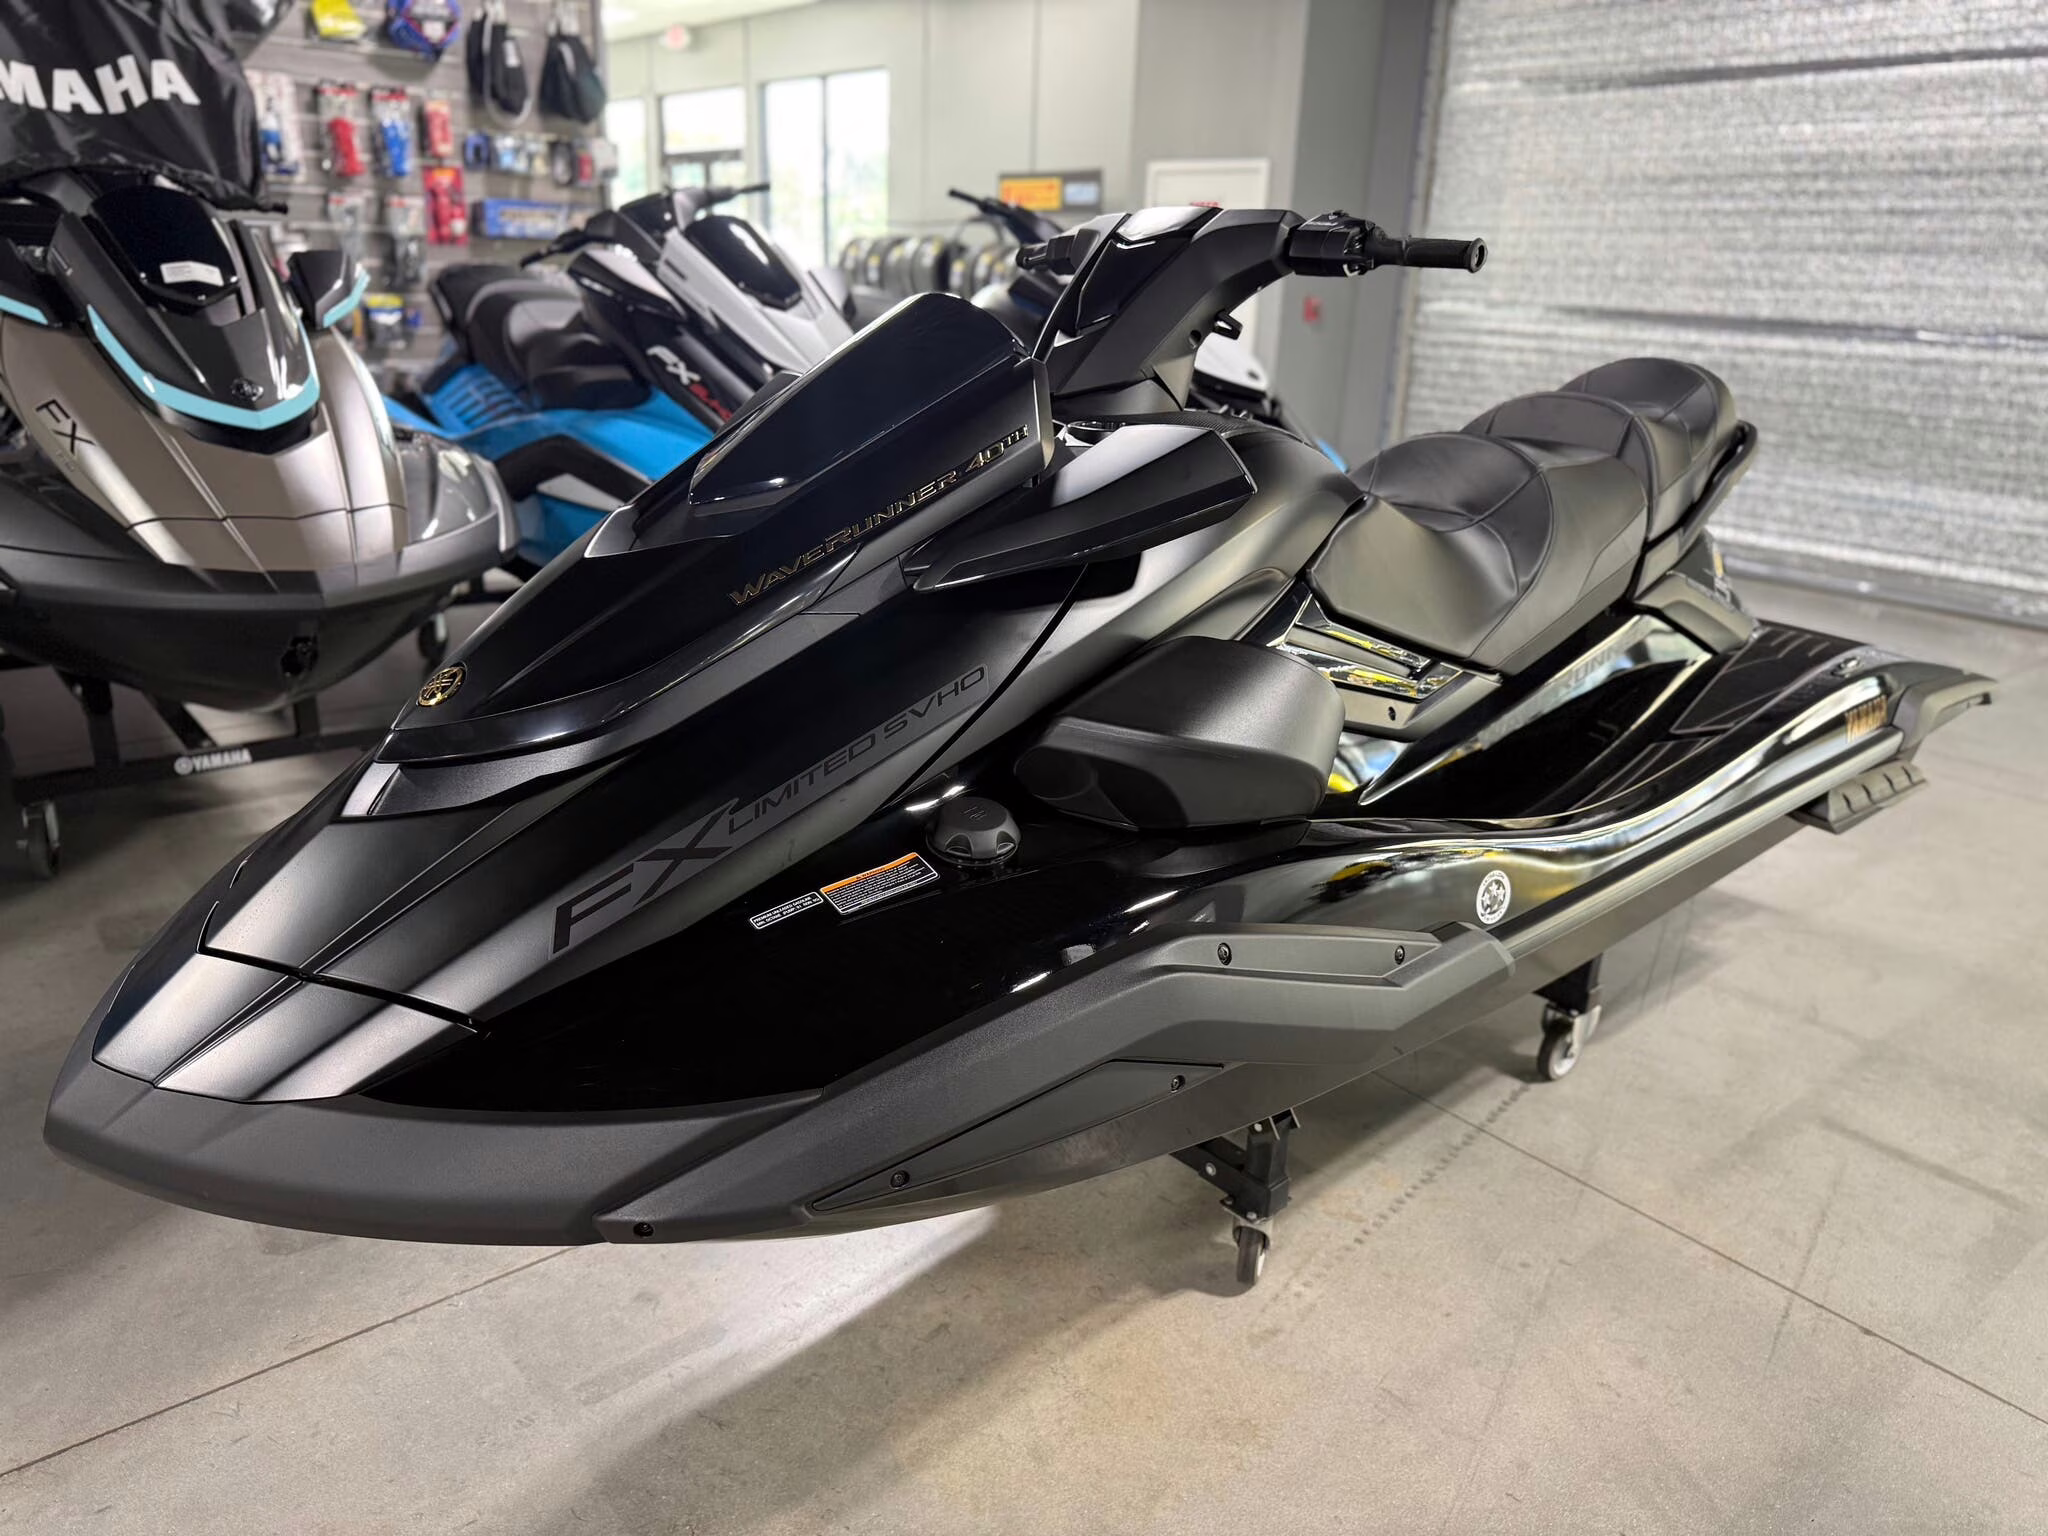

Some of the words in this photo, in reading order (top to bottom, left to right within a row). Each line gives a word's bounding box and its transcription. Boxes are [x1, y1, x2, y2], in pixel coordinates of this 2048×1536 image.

[36, 399, 97, 455] FX
[728, 469, 958, 606] WAVERUNNER
[966, 424, 1029, 473] 40TH
[192, 747, 252, 772] YAMAHA
[552, 797, 738, 955] FX
[728, 732, 878, 836] LIMITED
[882, 665, 986, 740] SVHO
